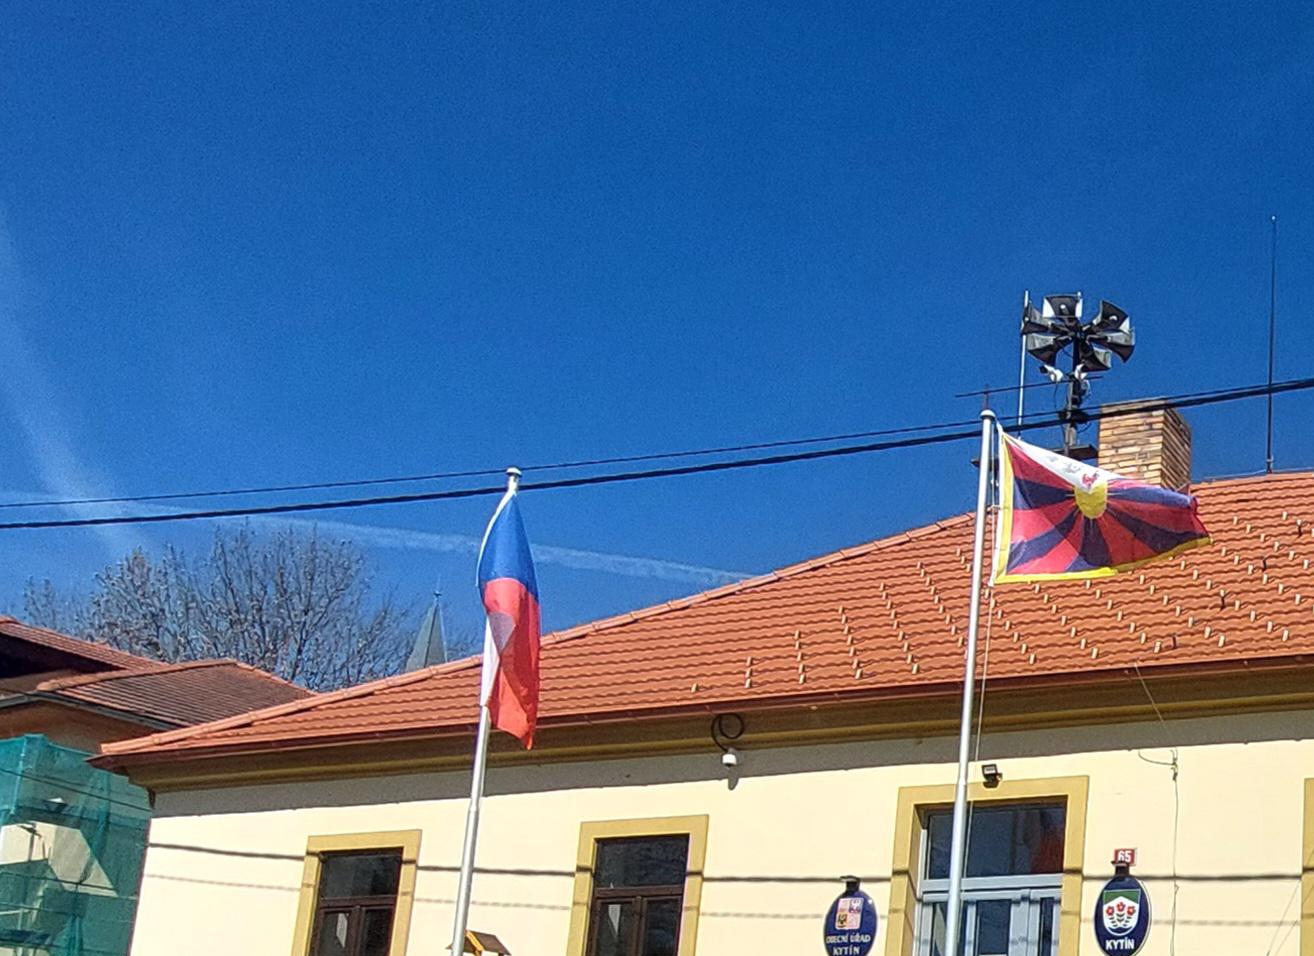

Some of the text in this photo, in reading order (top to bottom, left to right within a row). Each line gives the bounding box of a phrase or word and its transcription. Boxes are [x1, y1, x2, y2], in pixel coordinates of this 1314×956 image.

[1117, 850, 1132, 864] 65
[826, 932, 871, 944] OBECNÍ ÚŘAD
[1105, 937, 1135, 950] KYTÍN
[833, 944, 860, 956] KYTÍN
